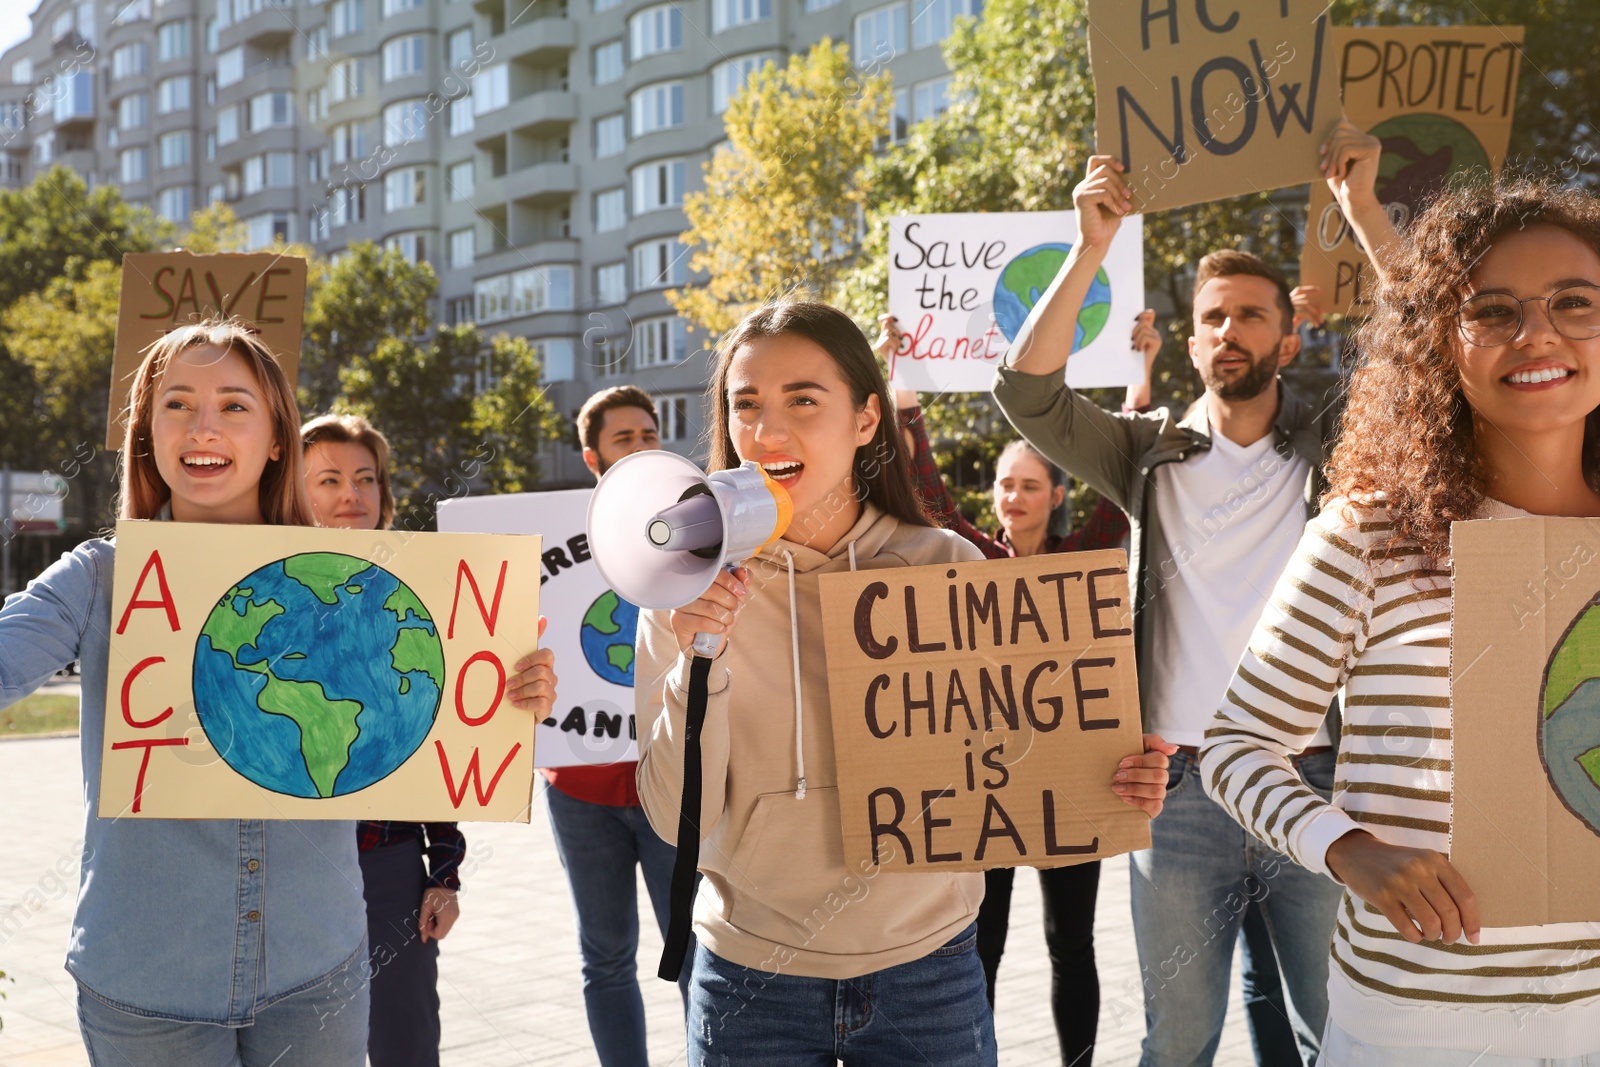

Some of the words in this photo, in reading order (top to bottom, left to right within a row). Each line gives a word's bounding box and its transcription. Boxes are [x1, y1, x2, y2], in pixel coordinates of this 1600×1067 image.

[1116, 15, 1327, 174] NOW
[1340, 39, 1522, 118] PROTECT
[894, 222, 1006, 270] Save
[140, 266, 291, 324] SAVE
[915, 273, 980, 311] the
[890, 313, 998, 381] planet
[111, 549, 189, 813] ACT
[434, 559, 521, 809] NOW
[864, 656, 1120, 739] CHANGE
[867, 786, 1099, 866] REAL
